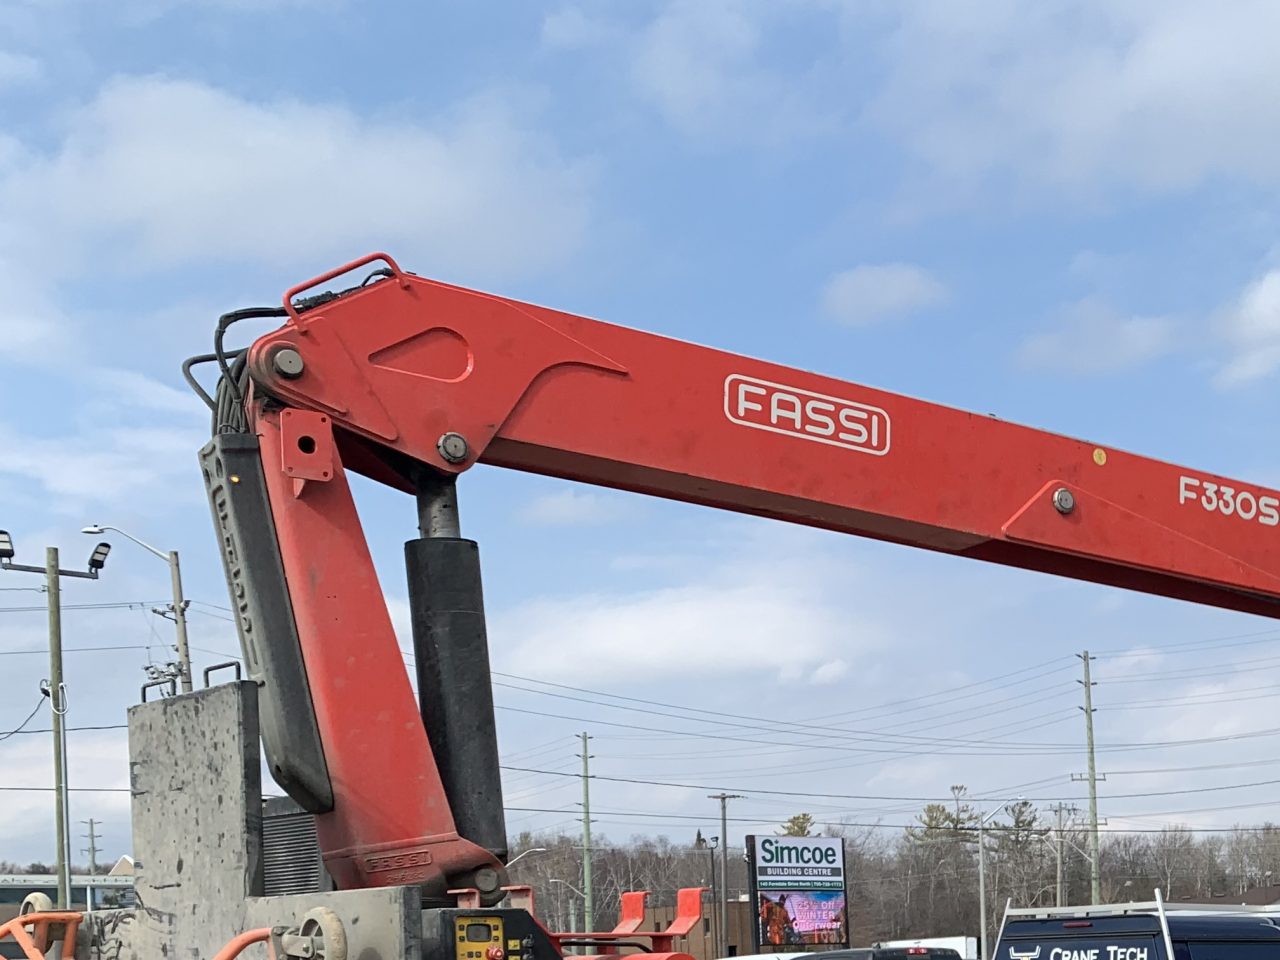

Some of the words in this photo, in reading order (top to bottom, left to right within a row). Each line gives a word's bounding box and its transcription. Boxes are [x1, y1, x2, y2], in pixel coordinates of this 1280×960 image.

[738, 383, 879, 447] FASSI
[761, 838, 836, 864] Simcoe
[767, 867, 802, 875] BUILDING
[804, 868, 832, 876] CENTRE
[799, 911, 835, 920] WINTER
[792, 921, 842, 929] Outerwear
